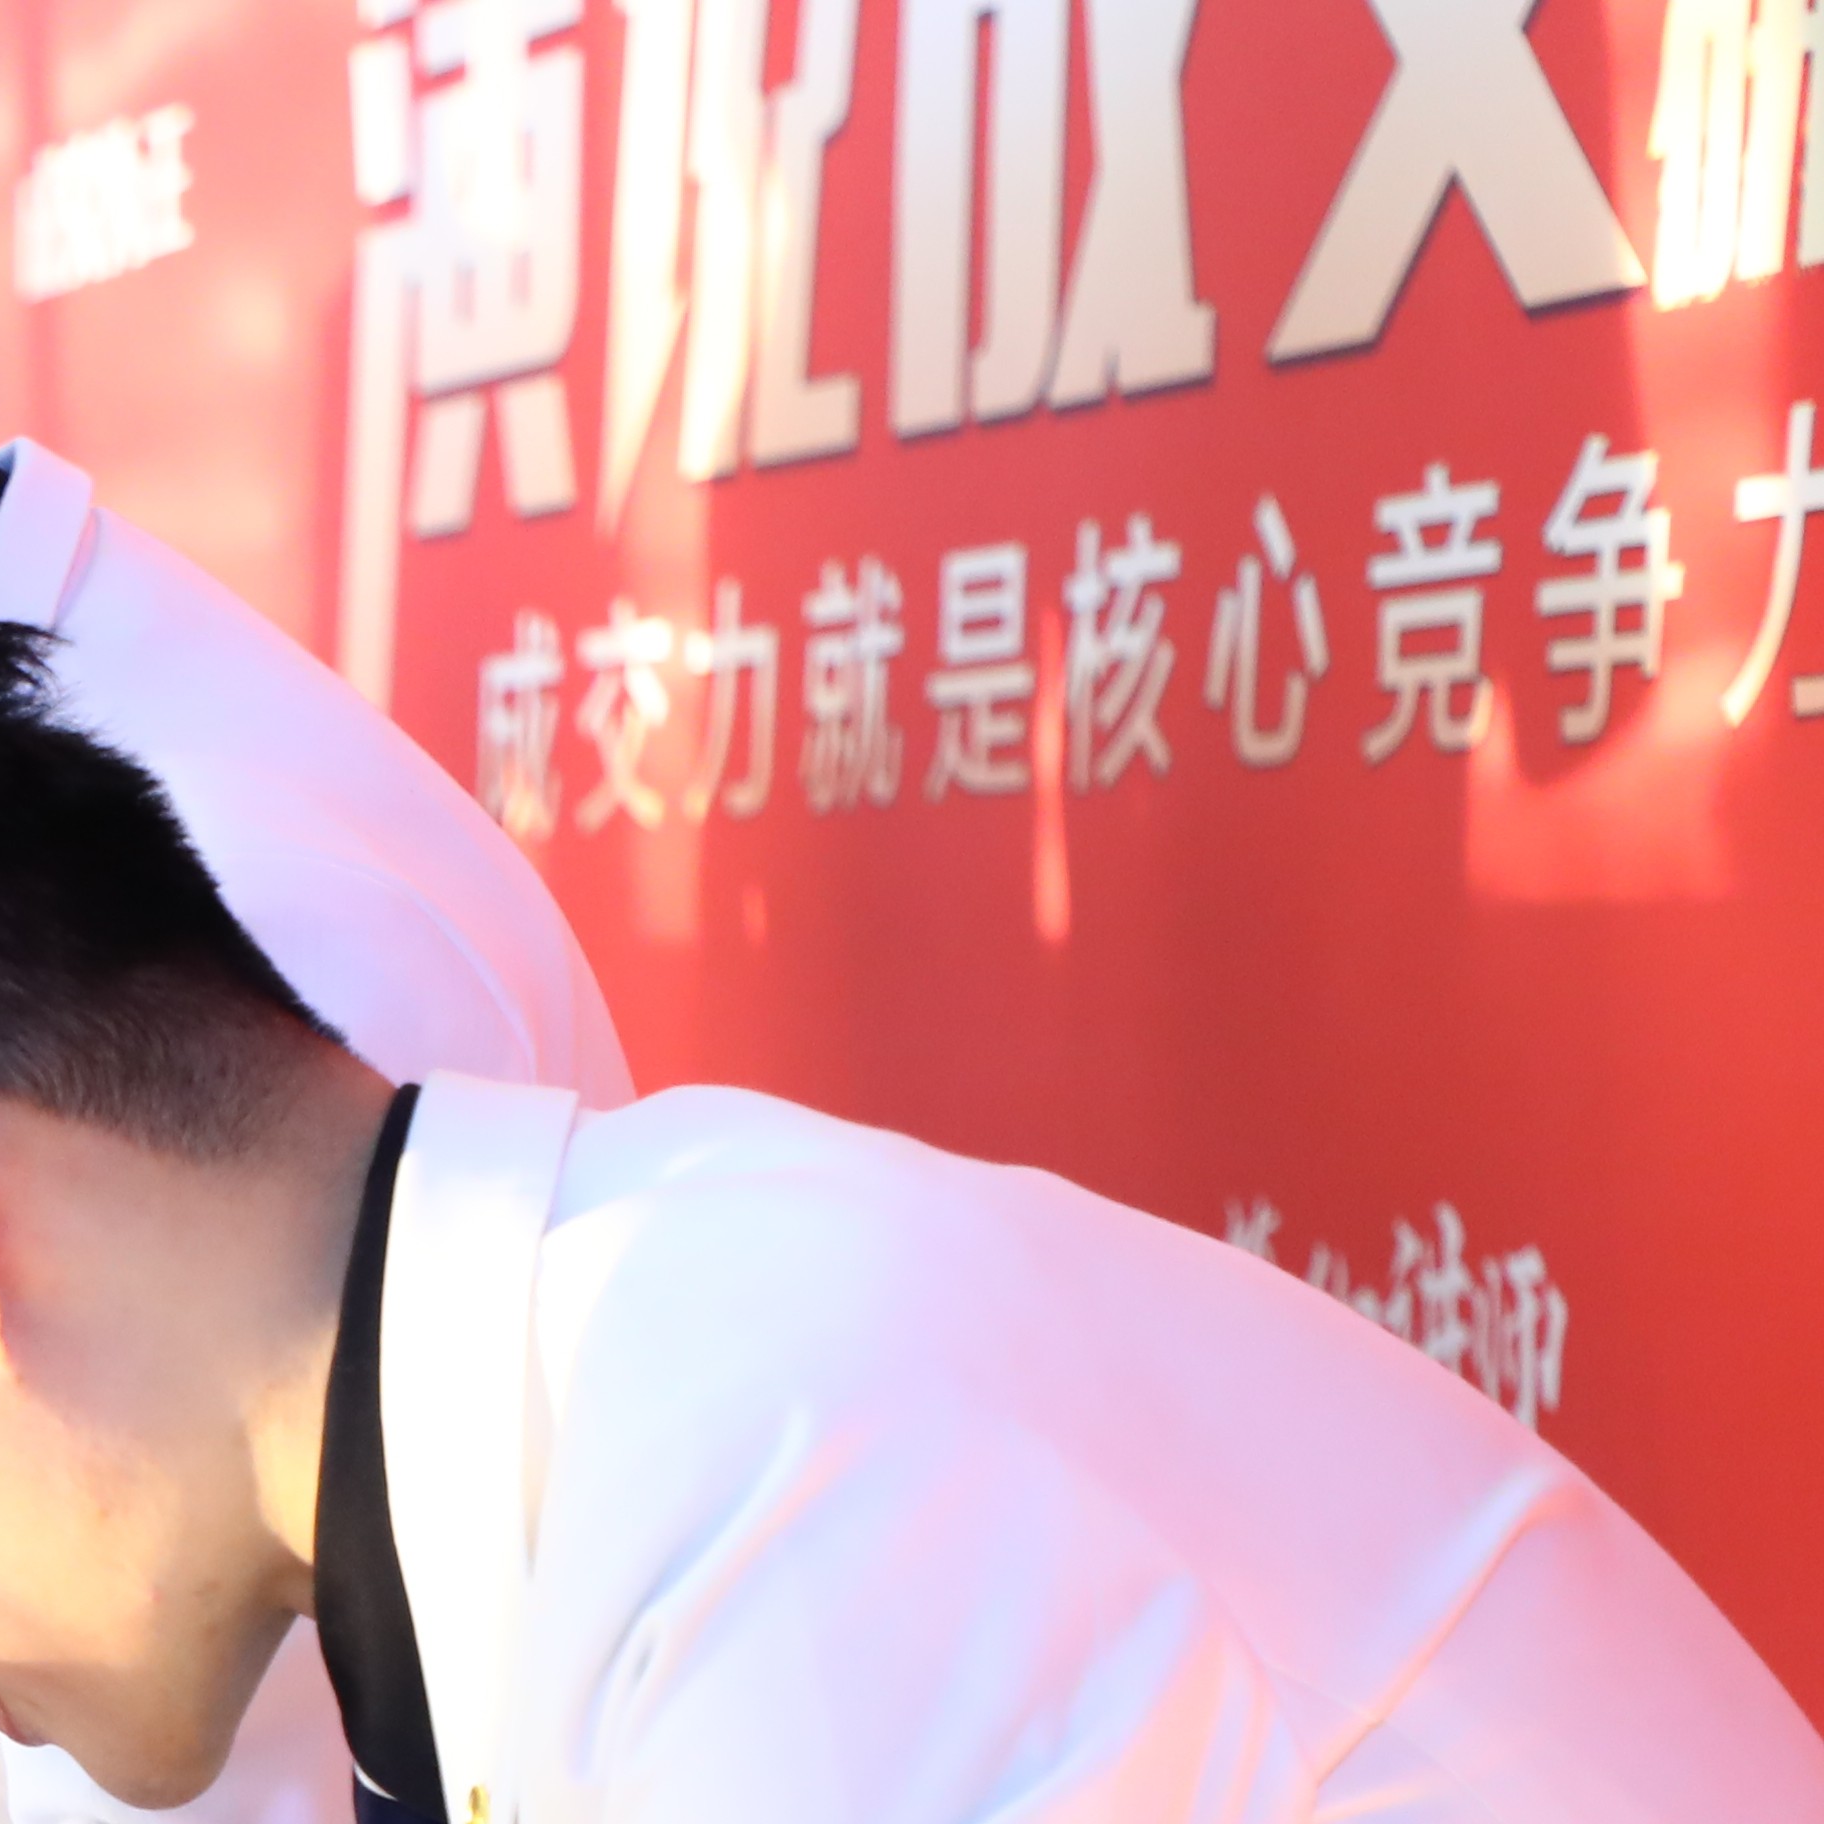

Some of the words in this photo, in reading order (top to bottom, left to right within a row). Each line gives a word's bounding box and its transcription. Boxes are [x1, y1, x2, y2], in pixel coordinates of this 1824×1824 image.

[474, 400, 1824, 840] 成交力就是核心竞争力
